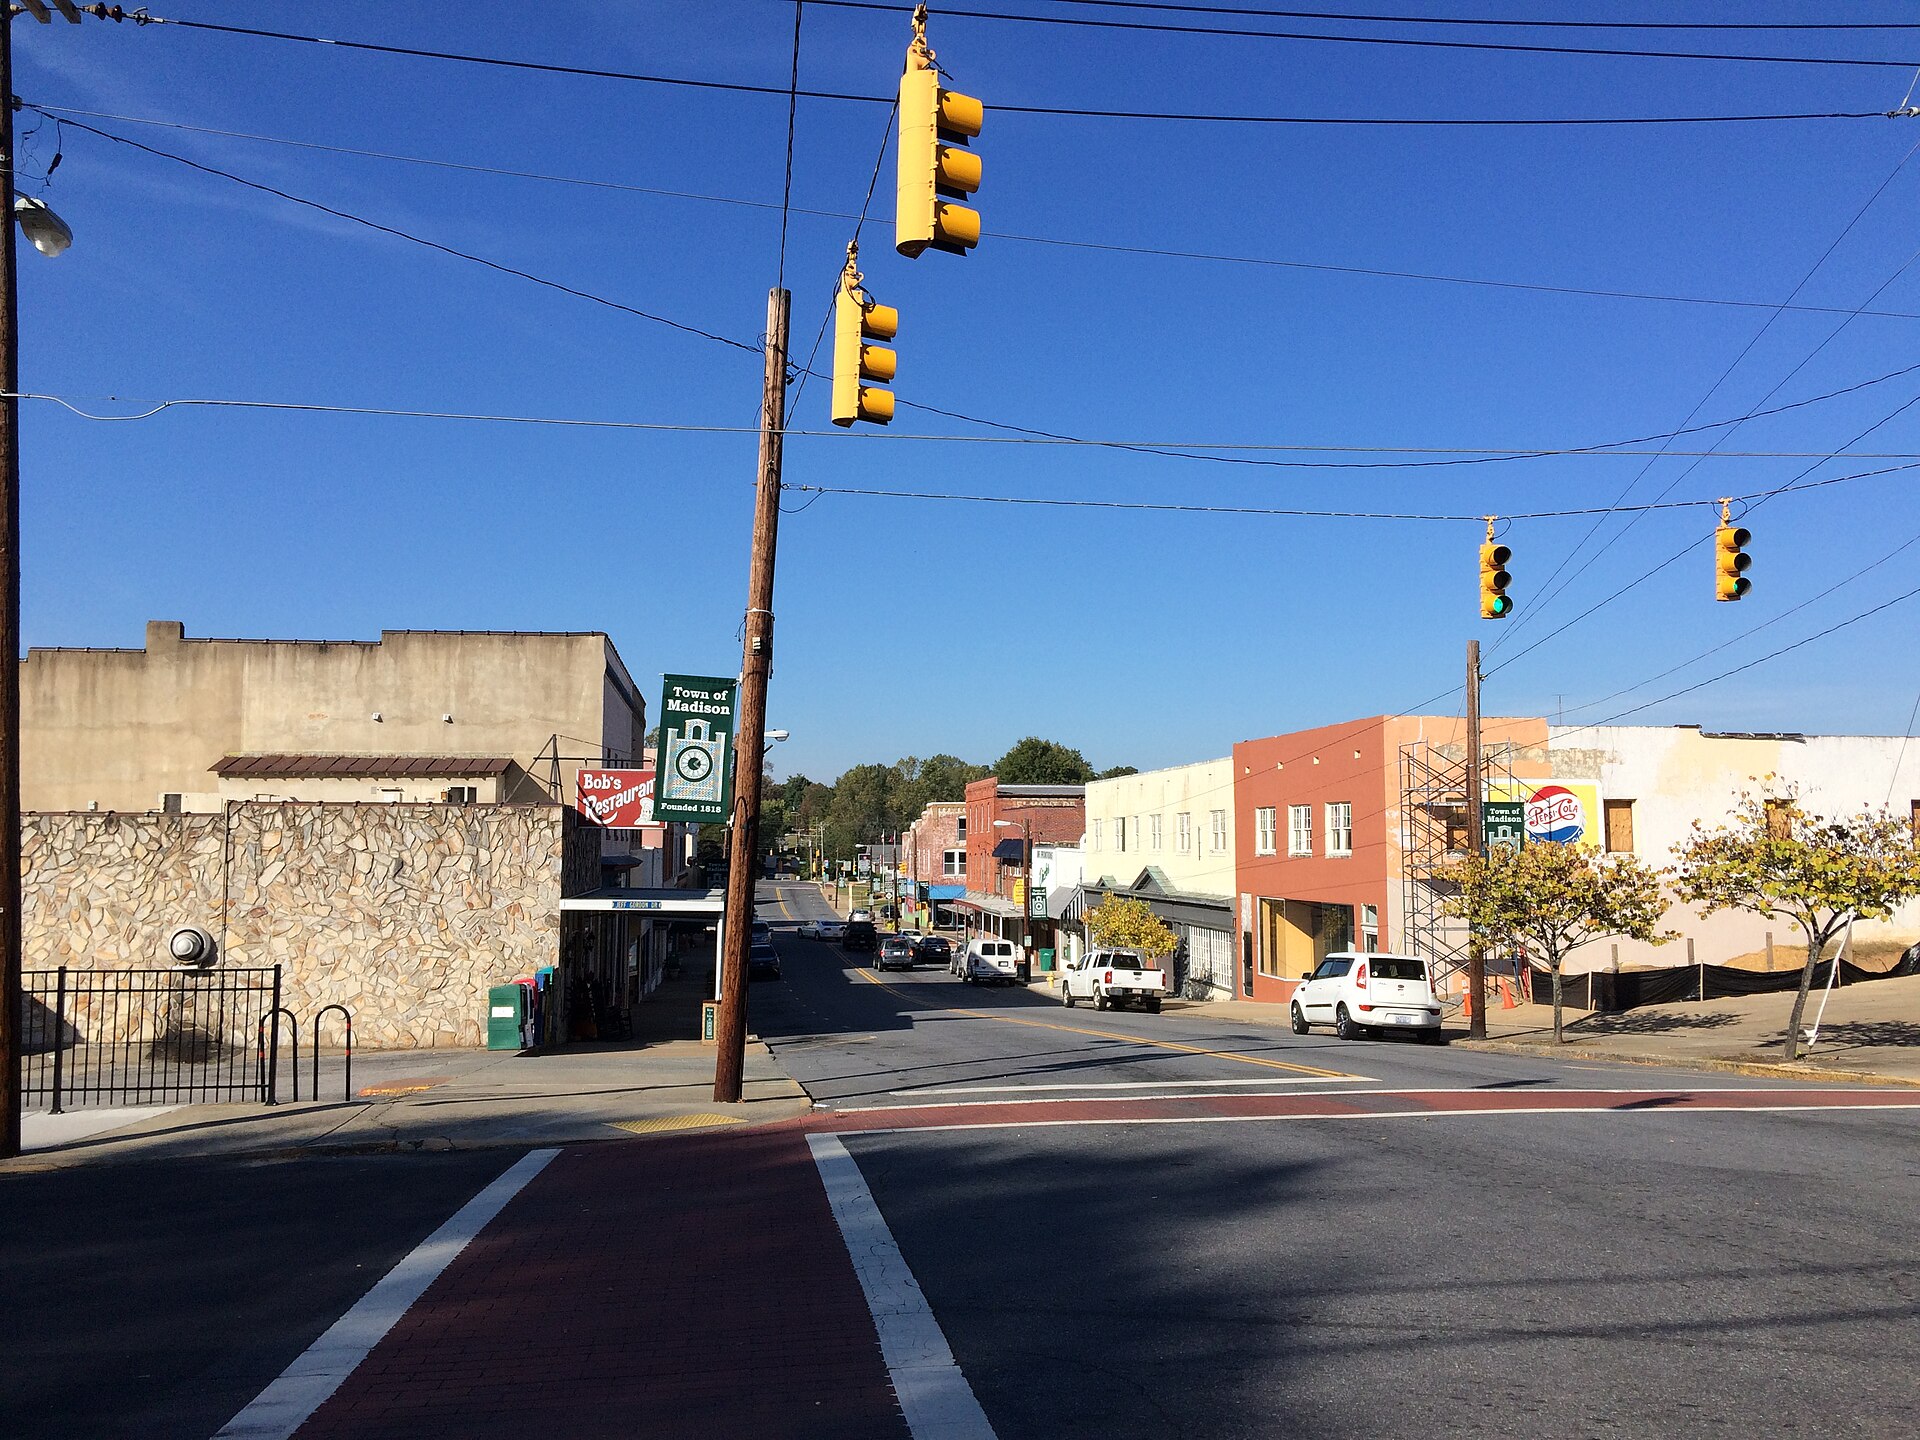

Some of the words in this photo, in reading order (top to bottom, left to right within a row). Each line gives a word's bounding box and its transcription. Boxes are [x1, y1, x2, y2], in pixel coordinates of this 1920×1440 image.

[673, 686, 709, 699] Town
[713, 690, 728, 701] of
[667, 699, 730, 715] Madison
[583, 773, 622, 790] Bob's
[582, 777, 656, 823] Restauran
[660, 803, 698, 812] Founded
[701, 803, 722, 813] 1818
[1487, 815, 1522, 823] Madison
